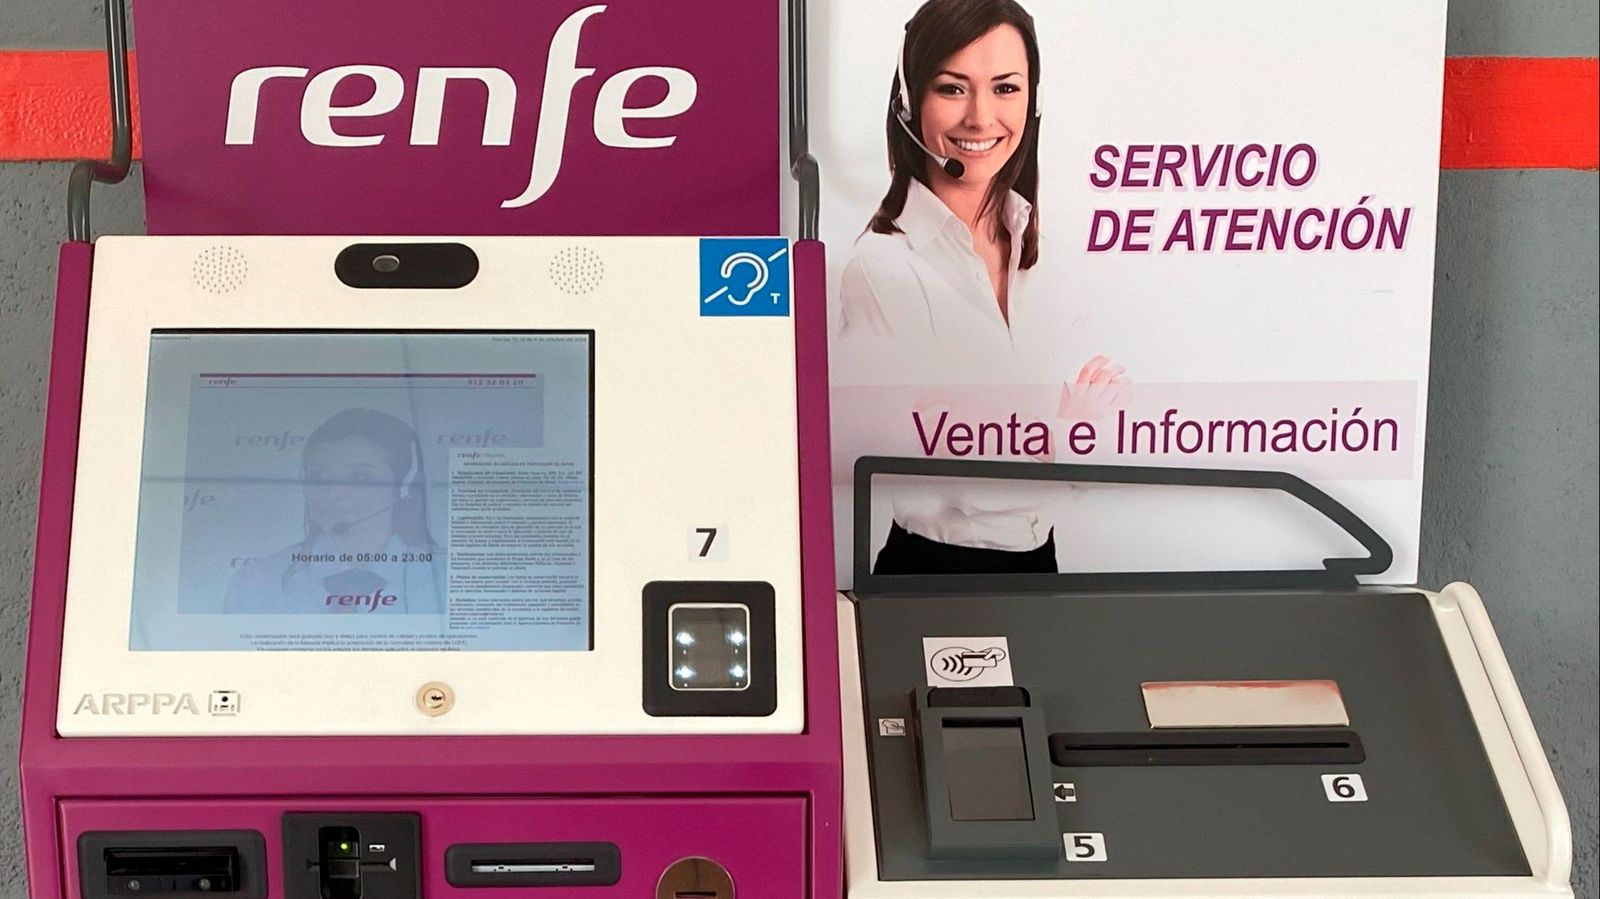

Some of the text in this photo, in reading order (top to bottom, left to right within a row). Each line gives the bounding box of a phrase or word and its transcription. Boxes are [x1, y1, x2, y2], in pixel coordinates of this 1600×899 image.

[224, 4, 698, 209] renfe
[1089, 143, 1317, 188] SERVICIO
[1087, 195, 1411, 252] DE ATENCIÓN
[770, 292, 781, 305] T
[912, 407, 1399, 456] Venta e Información
[695, 527, 717, 557] 7
[291, 552, 433, 563] Horario de 05:00 a 23:00
[325, 589, 398, 612] renfe
[73, 692, 200, 715] ARPPA
[1332, 776, 1356, 799] 6
[1073, 835, 1096, 858] 5
